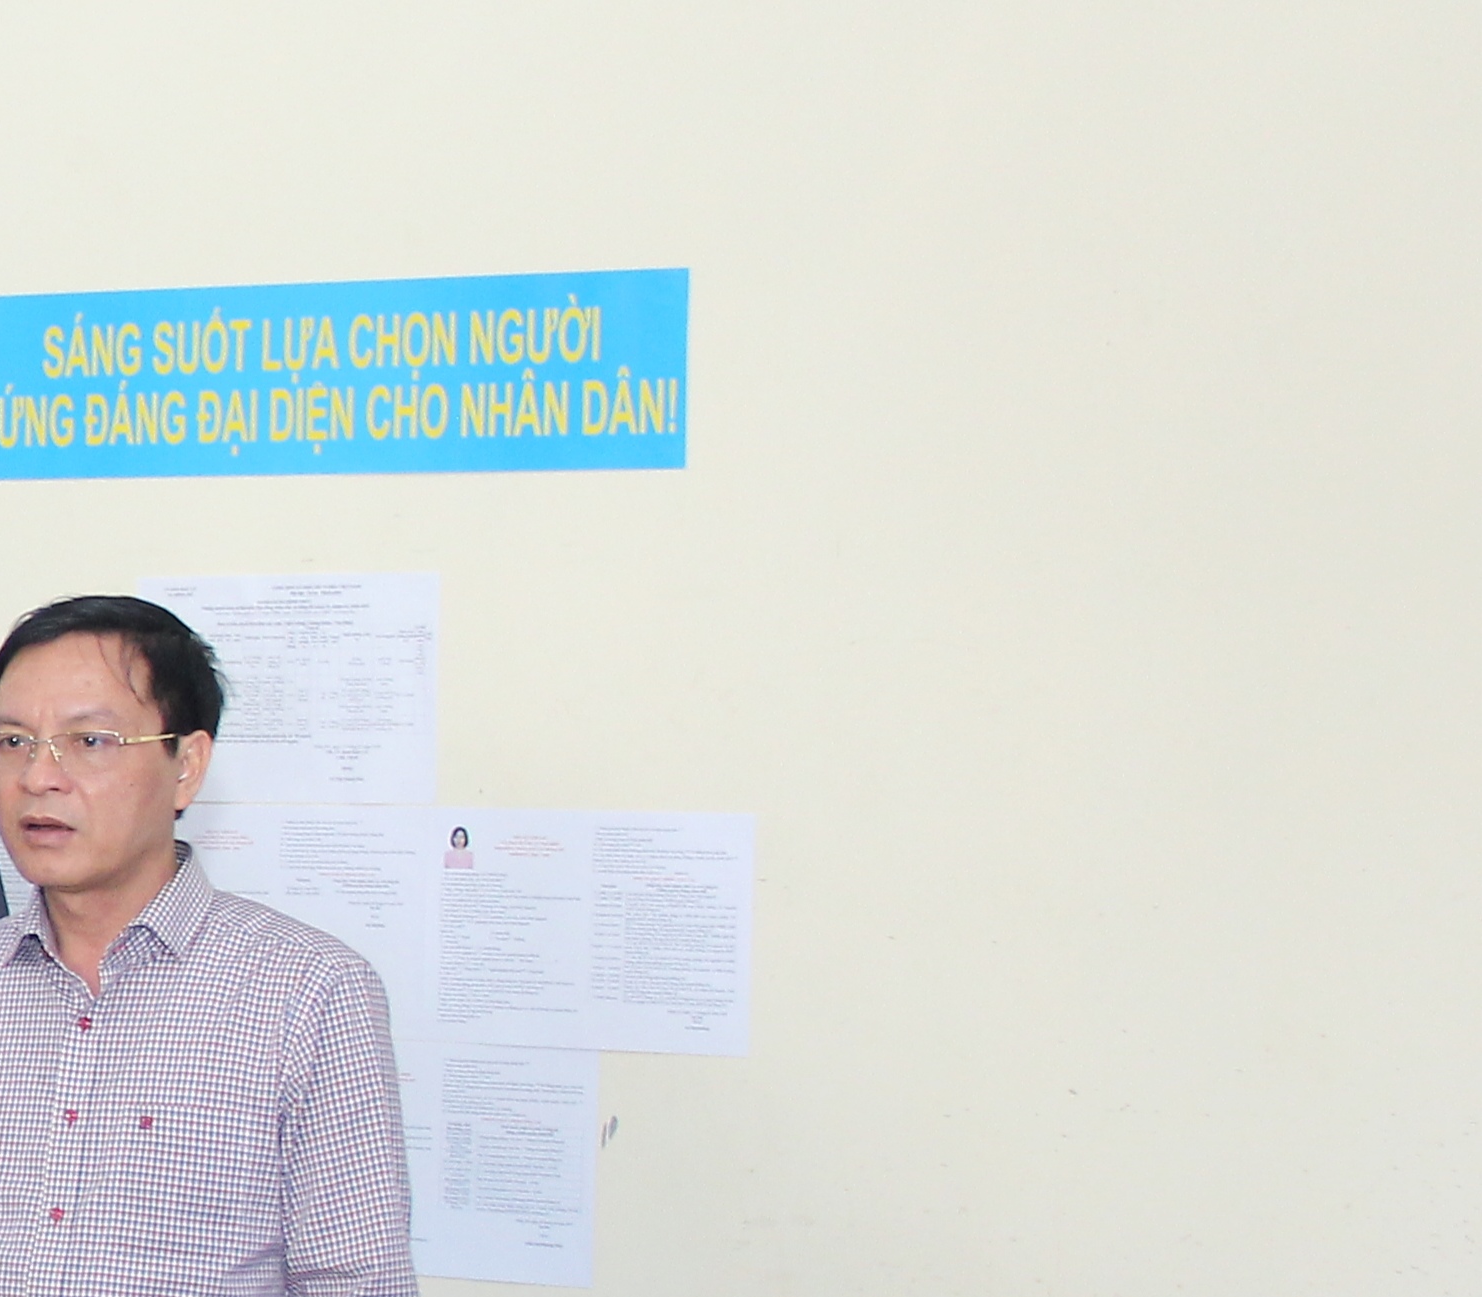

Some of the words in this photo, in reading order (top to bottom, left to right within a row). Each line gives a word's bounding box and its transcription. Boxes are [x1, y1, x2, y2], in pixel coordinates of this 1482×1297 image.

[43, 313, 142, 378] SÁNG
[153, 307, 252, 374] SUỐT
[262, 316, 339, 383] LỰA
[348, 312, 457, 379] CHỌN
[470, 293, 600, 365] NGƯỜI
[84, 383, 187, 445] ĐÁNG
[196, 391, 258, 456] ĐẠI
[269, 383, 354, 454] DIỆN
[366, 386, 449, 439] CHO
[461, 371, 569, 437] NHÂN
[582, 368, 678, 435] DÂN!
